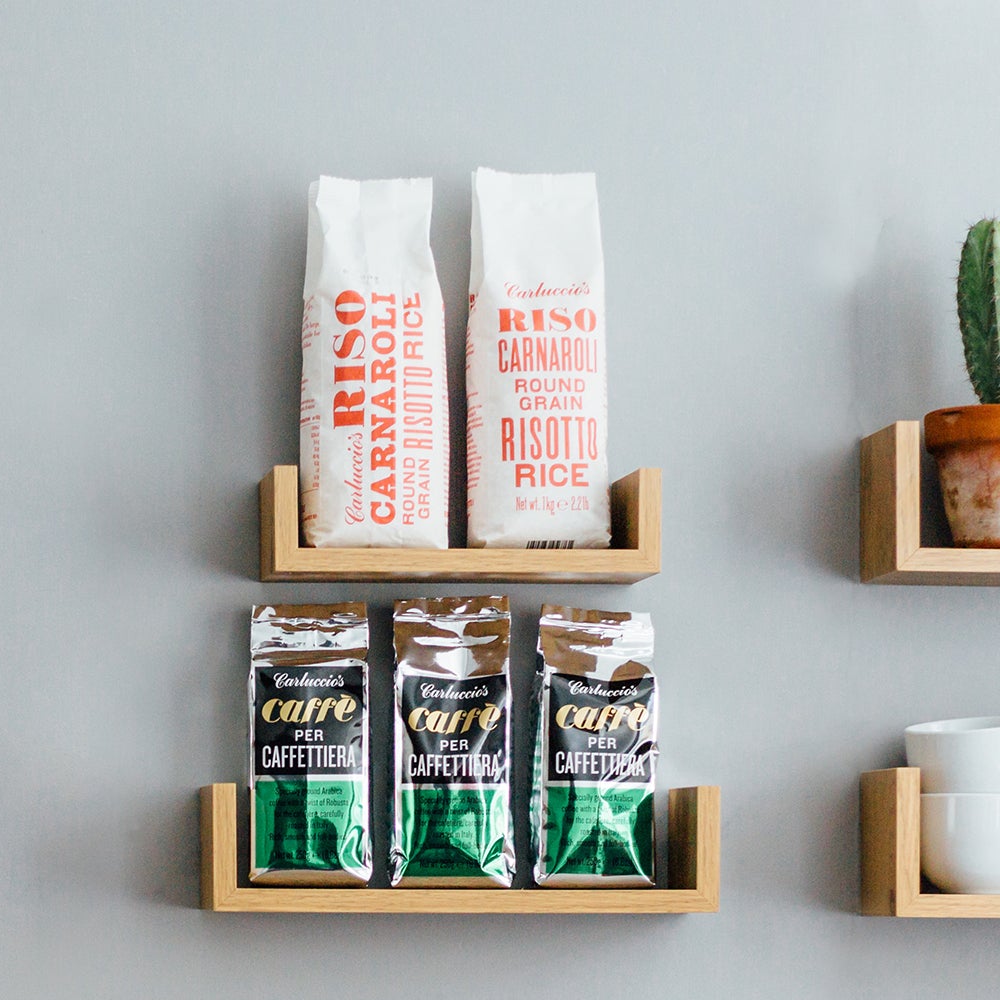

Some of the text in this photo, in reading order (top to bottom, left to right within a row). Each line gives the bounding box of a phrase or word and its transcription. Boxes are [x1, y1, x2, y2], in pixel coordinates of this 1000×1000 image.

[504, 281, 590, 299] Carluccio's
[497, 307, 597, 333] RISO
[333, 290, 366, 429] RISO
[497, 336, 598, 374] CARNAROLI
[403, 292, 433, 450] RISOTTO RICE
[515, 377, 585, 393] ROUND
[370, 292, 396, 525] CARNAROLI
[519, 396, 583, 411] GRAIN
[501, 416, 598, 461] RISOTTO
[344, 432, 365, 525] Carluccio's
[515, 463, 589, 488] RICE
[402, 457, 415, 525] ROUND
[418, 459, 430, 519] GRAIN
[273, 672, 344, 689] Carluccio's
[420, 682, 489, 700] Carluccio's
[568, 680, 638, 697] Carluccio's
[261, 694, 357, 724] caffè
[408, 703, 501, 735] caffè
[555, 702, 649, 732] caffè
[294, 729, 324, 742] PER
[440, 739, 469, 752] PER
[588, 736, 617, 749] PER
[262, 745, 356, 769] CAFFETTIERA
[408, 753, 498, 777] CAFFETTIERA
[555, 751, 645, 776] CAFFETTIERA
